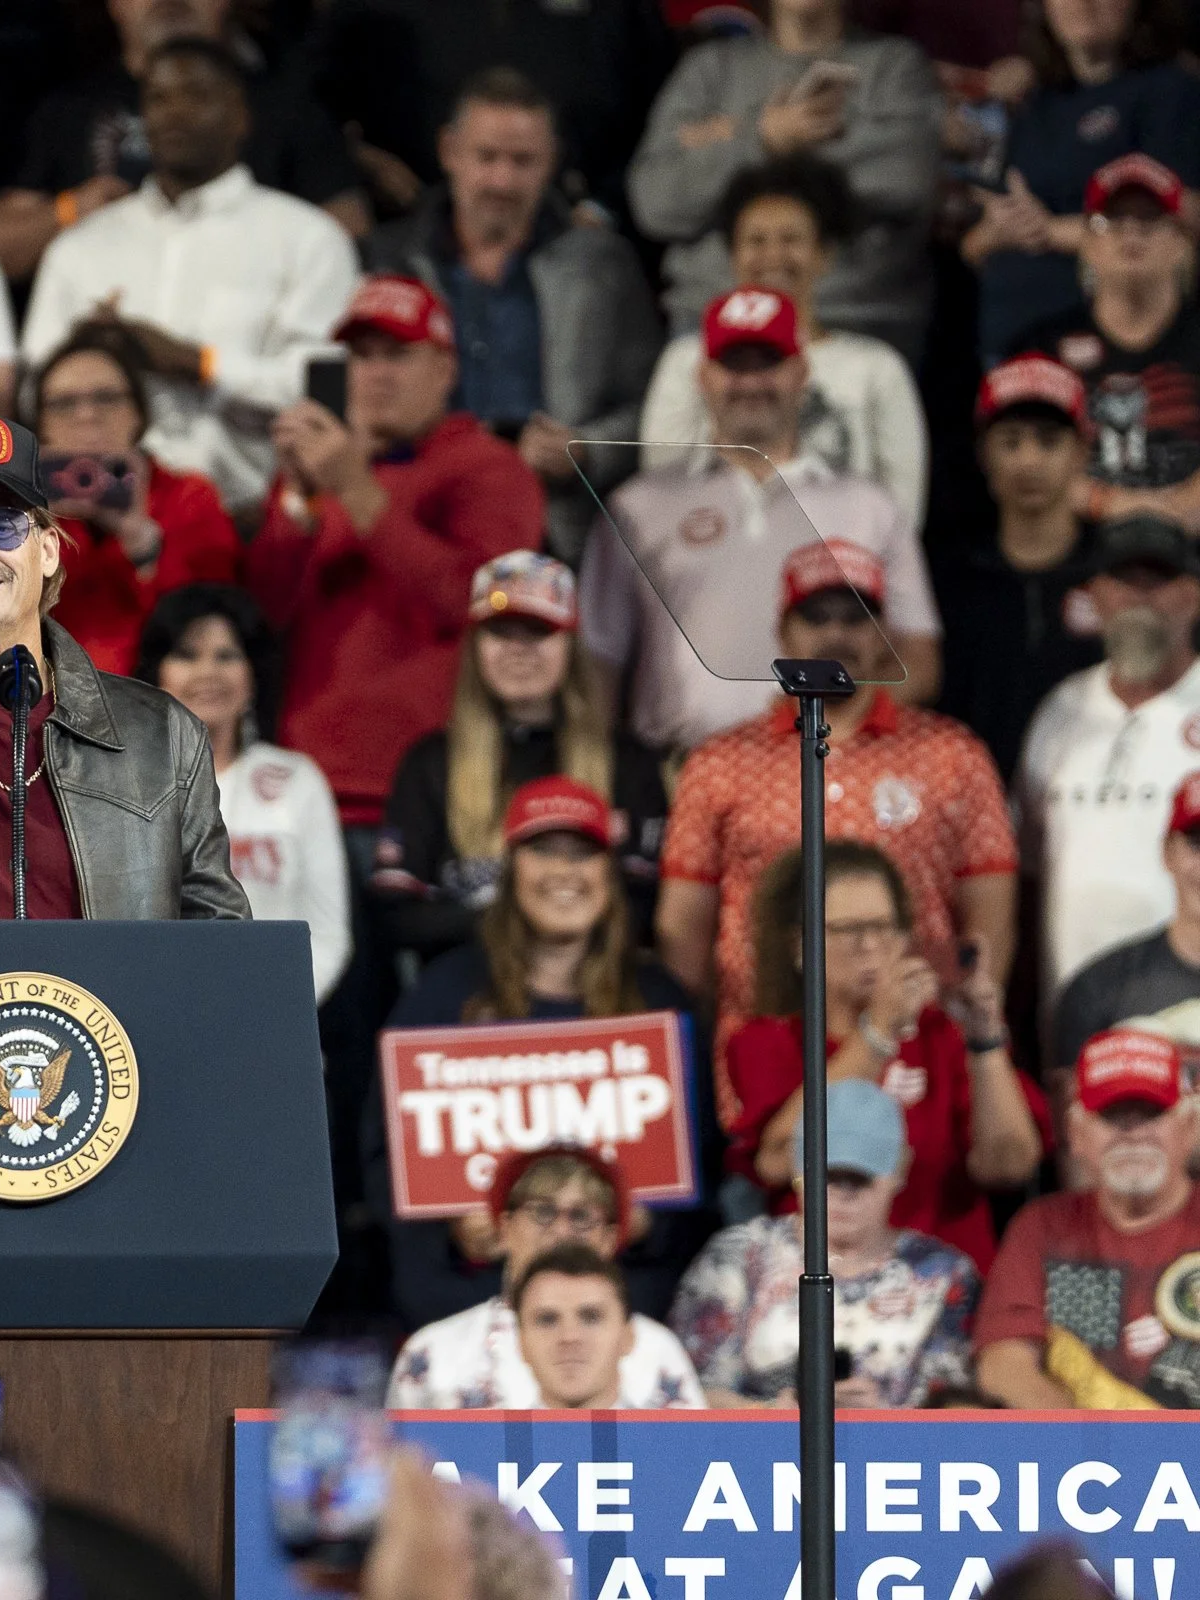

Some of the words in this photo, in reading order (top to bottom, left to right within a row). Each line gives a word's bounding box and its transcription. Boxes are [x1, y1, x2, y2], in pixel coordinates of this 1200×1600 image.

[26, 983, 48, 997] OF
[52, 988, 81, 1010] THE
[85, 1008, 131, 1101] UNITED
[400, 1074, 671, 1158] TRUMP
[44, 1121, 120, 1188] STATES
[431, 1461, 634, 1533] KE
